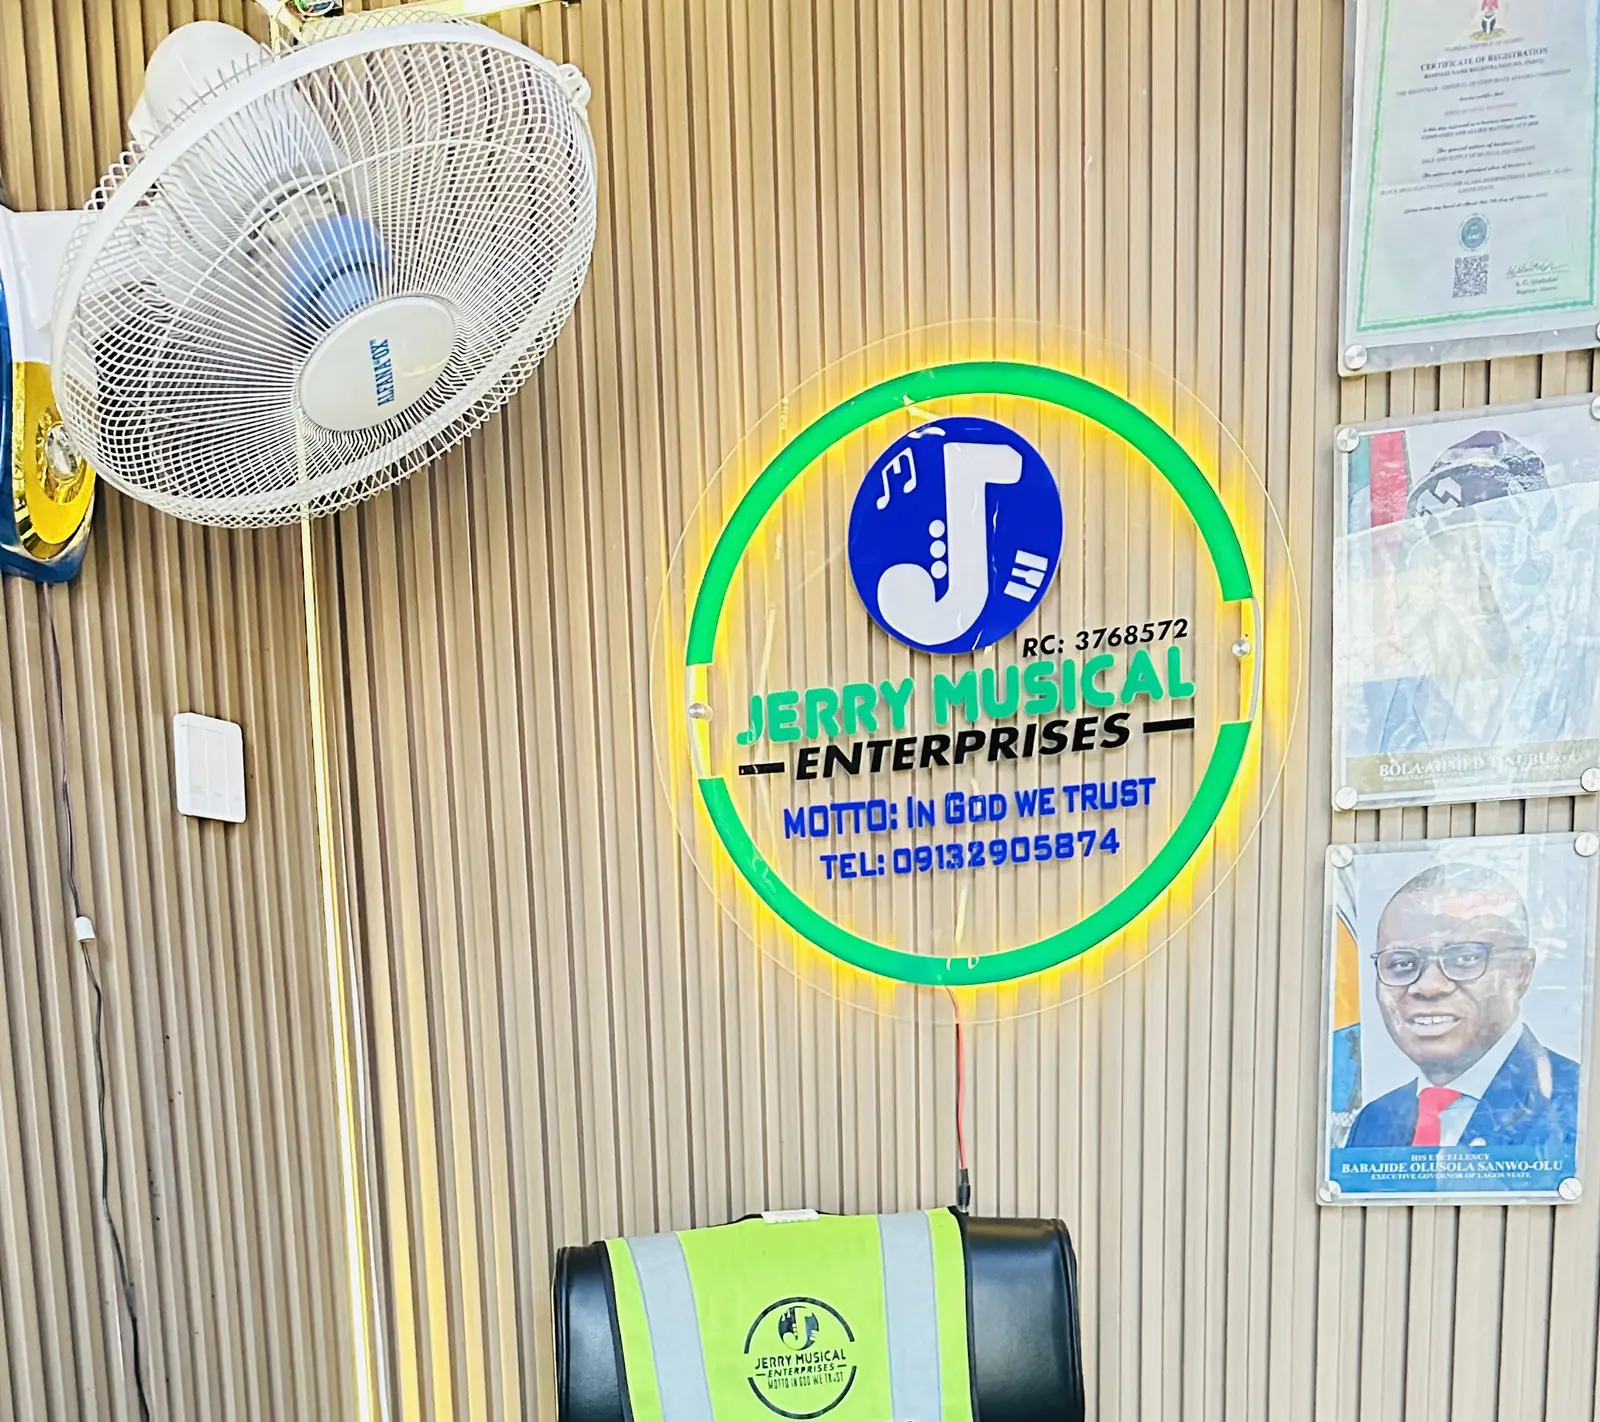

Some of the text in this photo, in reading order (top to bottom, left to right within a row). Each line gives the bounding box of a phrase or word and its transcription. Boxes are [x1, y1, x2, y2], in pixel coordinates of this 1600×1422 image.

[1420, 57, 1473, 71] CERTIFICATE
[1475, 55, 1485, 64] OF
[1487, 46, 1548, 62] REGISTRATION
[1022, 618, 1188, 659] RC: 3768572
[736, 645, 1195, 748] JERRY MUSICAL
[795, 711, 1131, 781] ENTERPRISES
[1380, 763, 1421, 777] BOLA
[783, 797, 897, 839] MOTTO:
[1015, 785, 1057, 816] WE
[1065, 777, 1156, 812] TRUST
[820, 827, 1120, 880] TEL: 09132905874
[1342, 1160, 1562, 1173] BABAJIDE OLUSOLA SANWO-OLU
[755, 1348, 847, 1370] JERRY MUSICAL
[768, 1362, 835, 1378] ENTERPRISES
[799, 1375, 811, 1387] GOD
[813, 1373, 823, 1385] WE
[824, 1371, 844, 1383] TRUST
